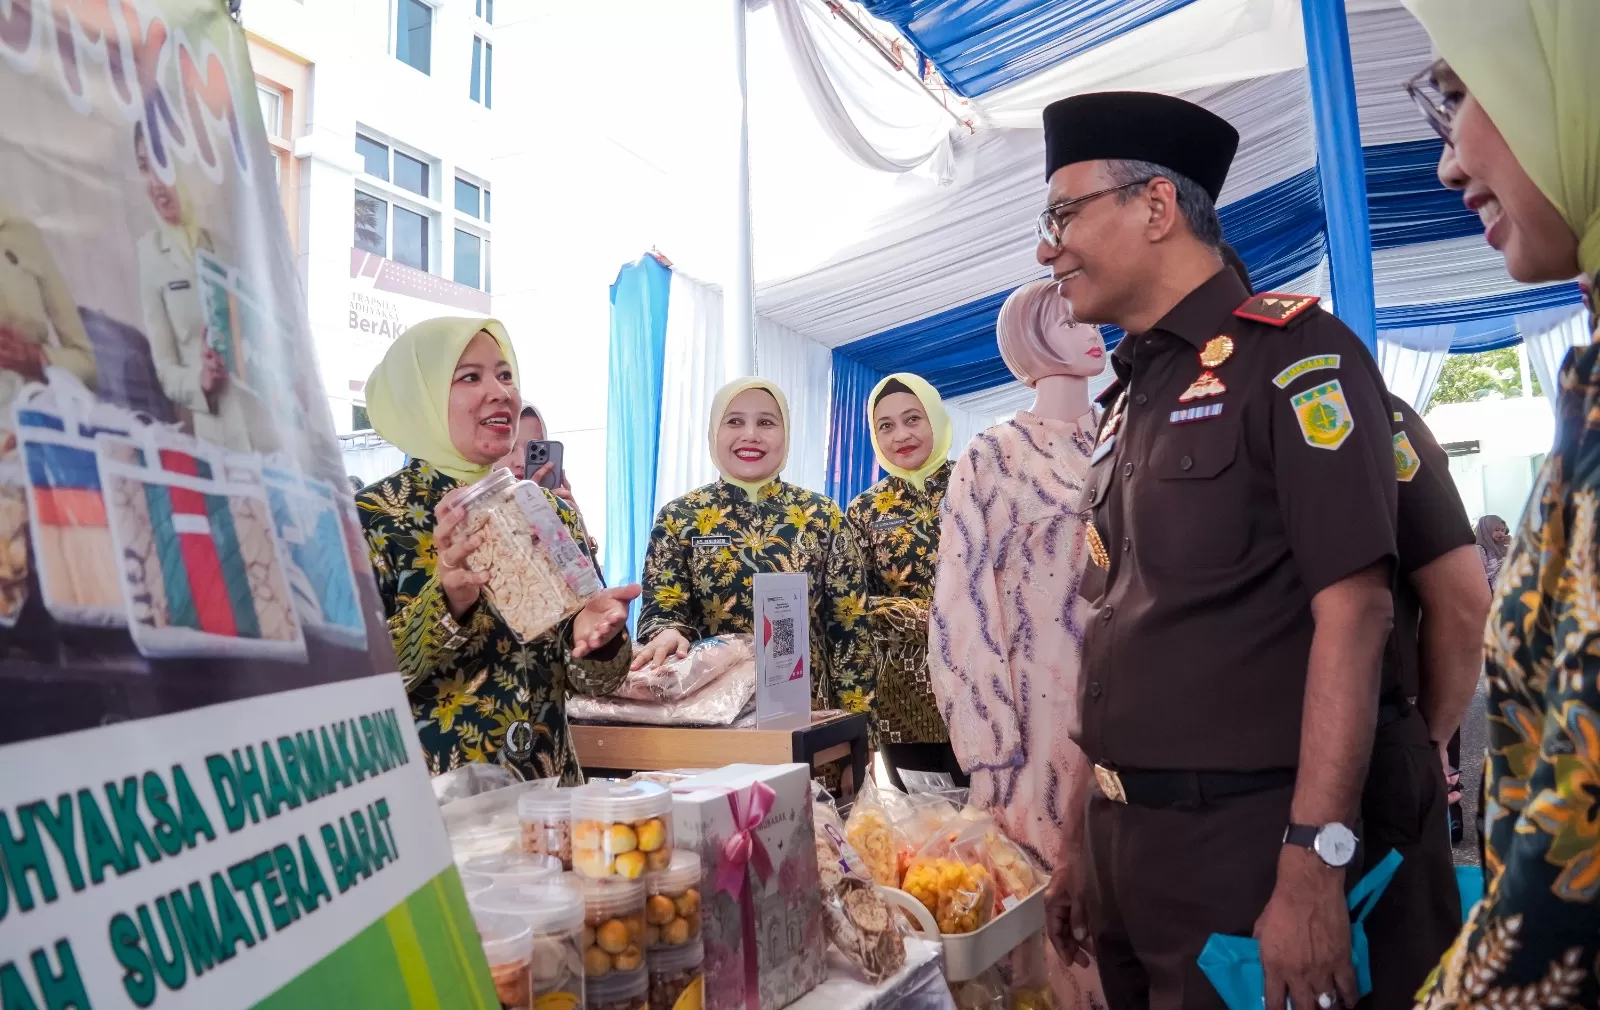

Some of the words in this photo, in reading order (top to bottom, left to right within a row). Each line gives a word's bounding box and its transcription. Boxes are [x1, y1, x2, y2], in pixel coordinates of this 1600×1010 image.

[349, 301, 399, 320] ADHYAKSA
[351, 292, 397, 311] TRAPSILA
[349, 309, 407, 339] BerAK
[0, 764, 217, 922] HYAKSA
[206, 708, 410, 834] DHARMAKARINI
[109, 834, 332, 1008] SUMATERA
[320, 797, 400, 893] BARAT
